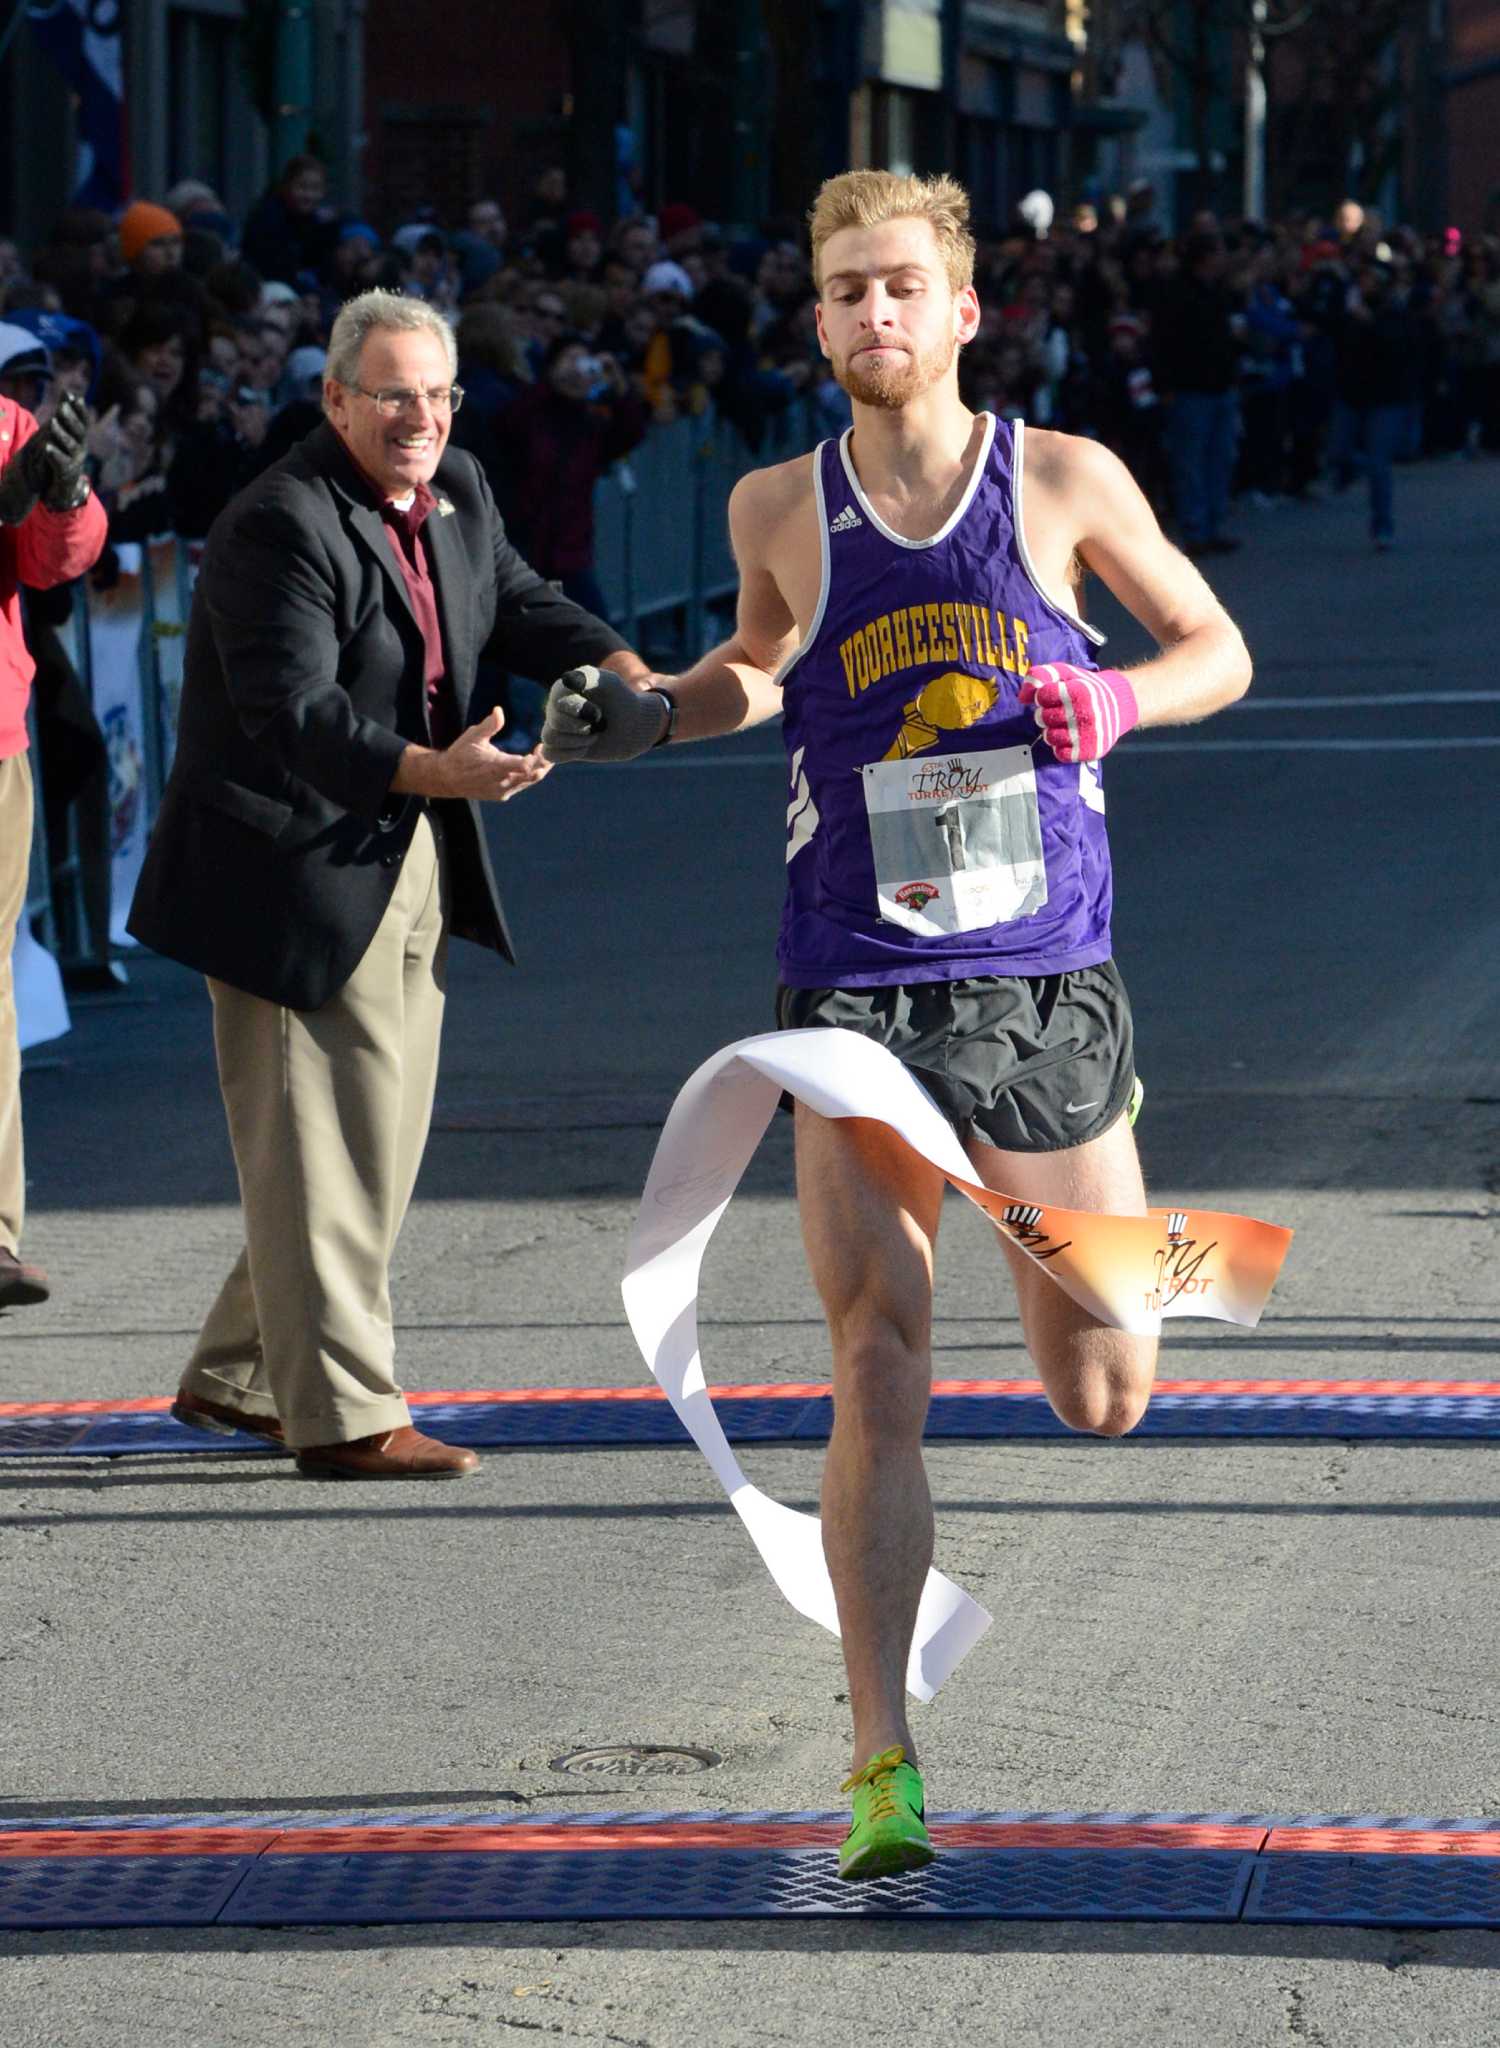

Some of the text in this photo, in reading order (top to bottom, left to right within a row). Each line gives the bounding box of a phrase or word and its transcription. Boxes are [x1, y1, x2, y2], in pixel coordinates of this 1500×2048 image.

[831, 515, 863, 533] adidas
[839, 602, 1030, 698] VOORHEESVILLE
[907, 787, 954, 801] TURKEY
[935, 806, 966, 871] 1
